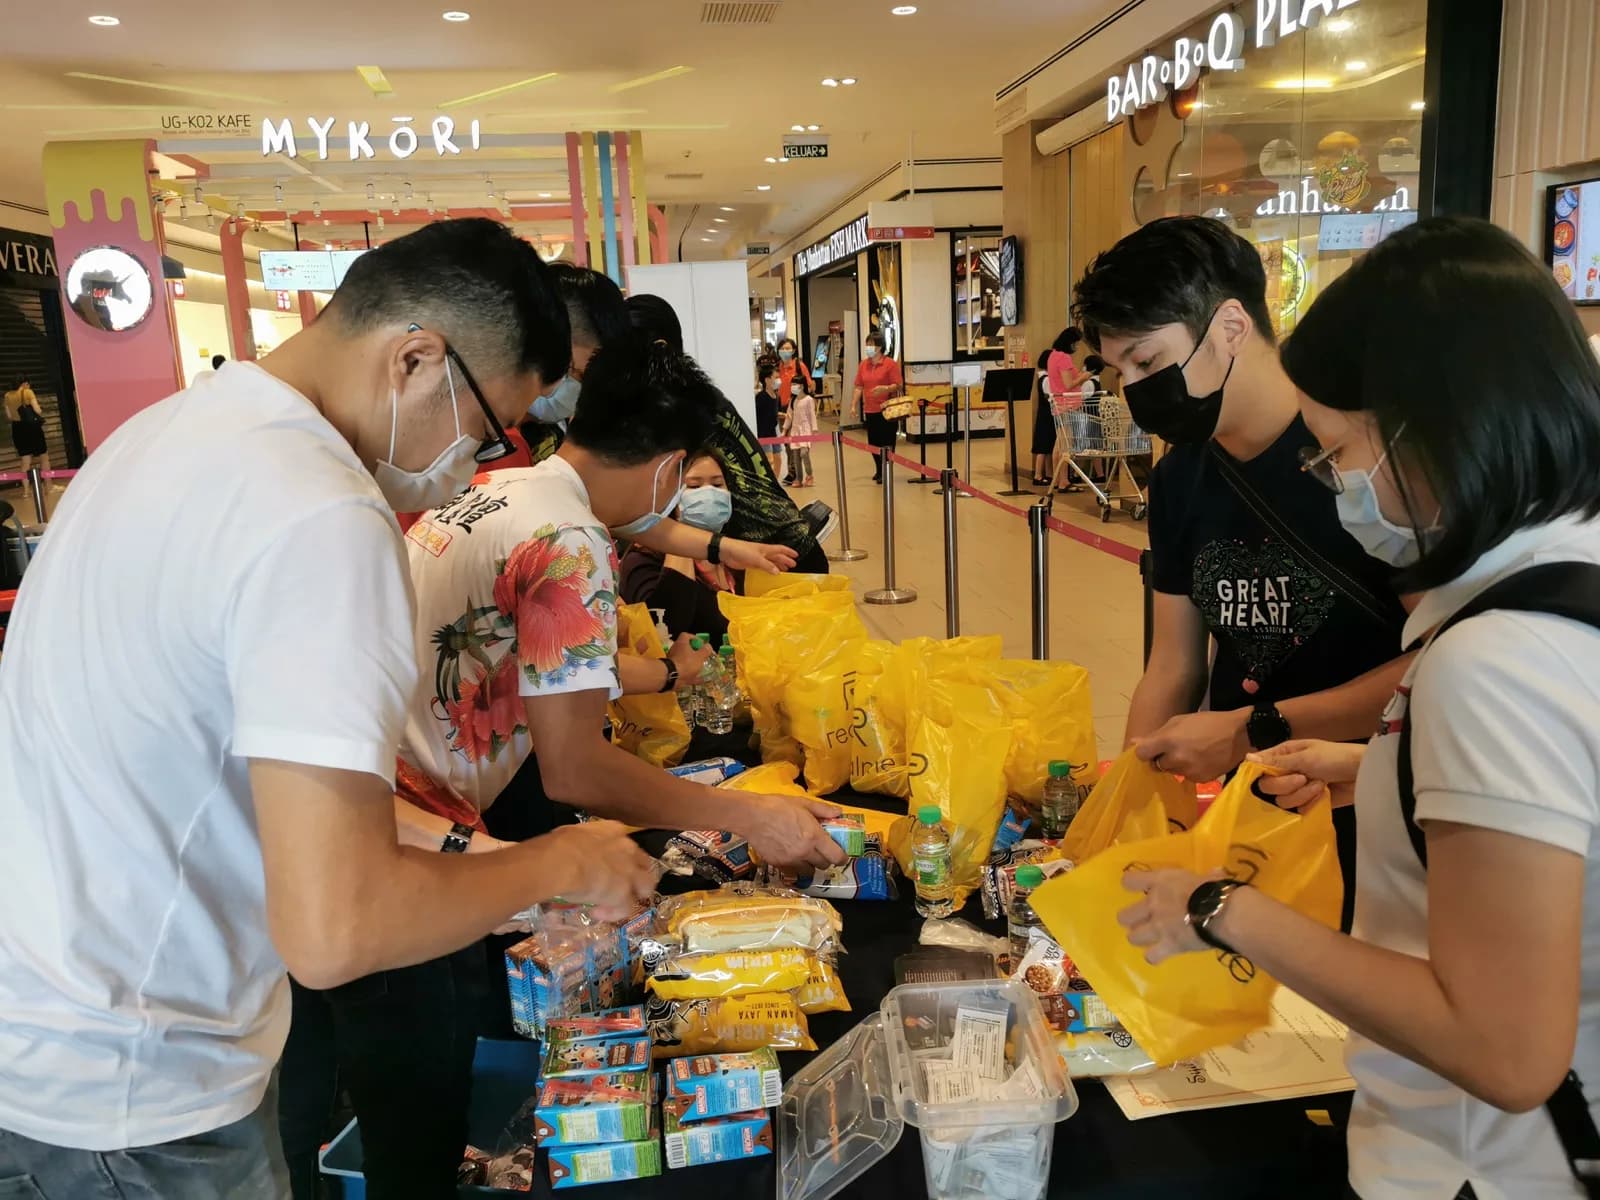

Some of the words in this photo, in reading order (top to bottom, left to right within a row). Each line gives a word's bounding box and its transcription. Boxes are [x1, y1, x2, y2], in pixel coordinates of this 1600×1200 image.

[1256, 0, 1361, 48] PLA
[217, 114, 252, 128] KAFE
[262, 116, 480, 160] MYKŌRI
[784, 145, 819, 158] KELUAR
[830, 229, 845, 262] FISH
[1217, 576, 1290, 602] GREAT
[1220, 602, 1292, 627] HEART
